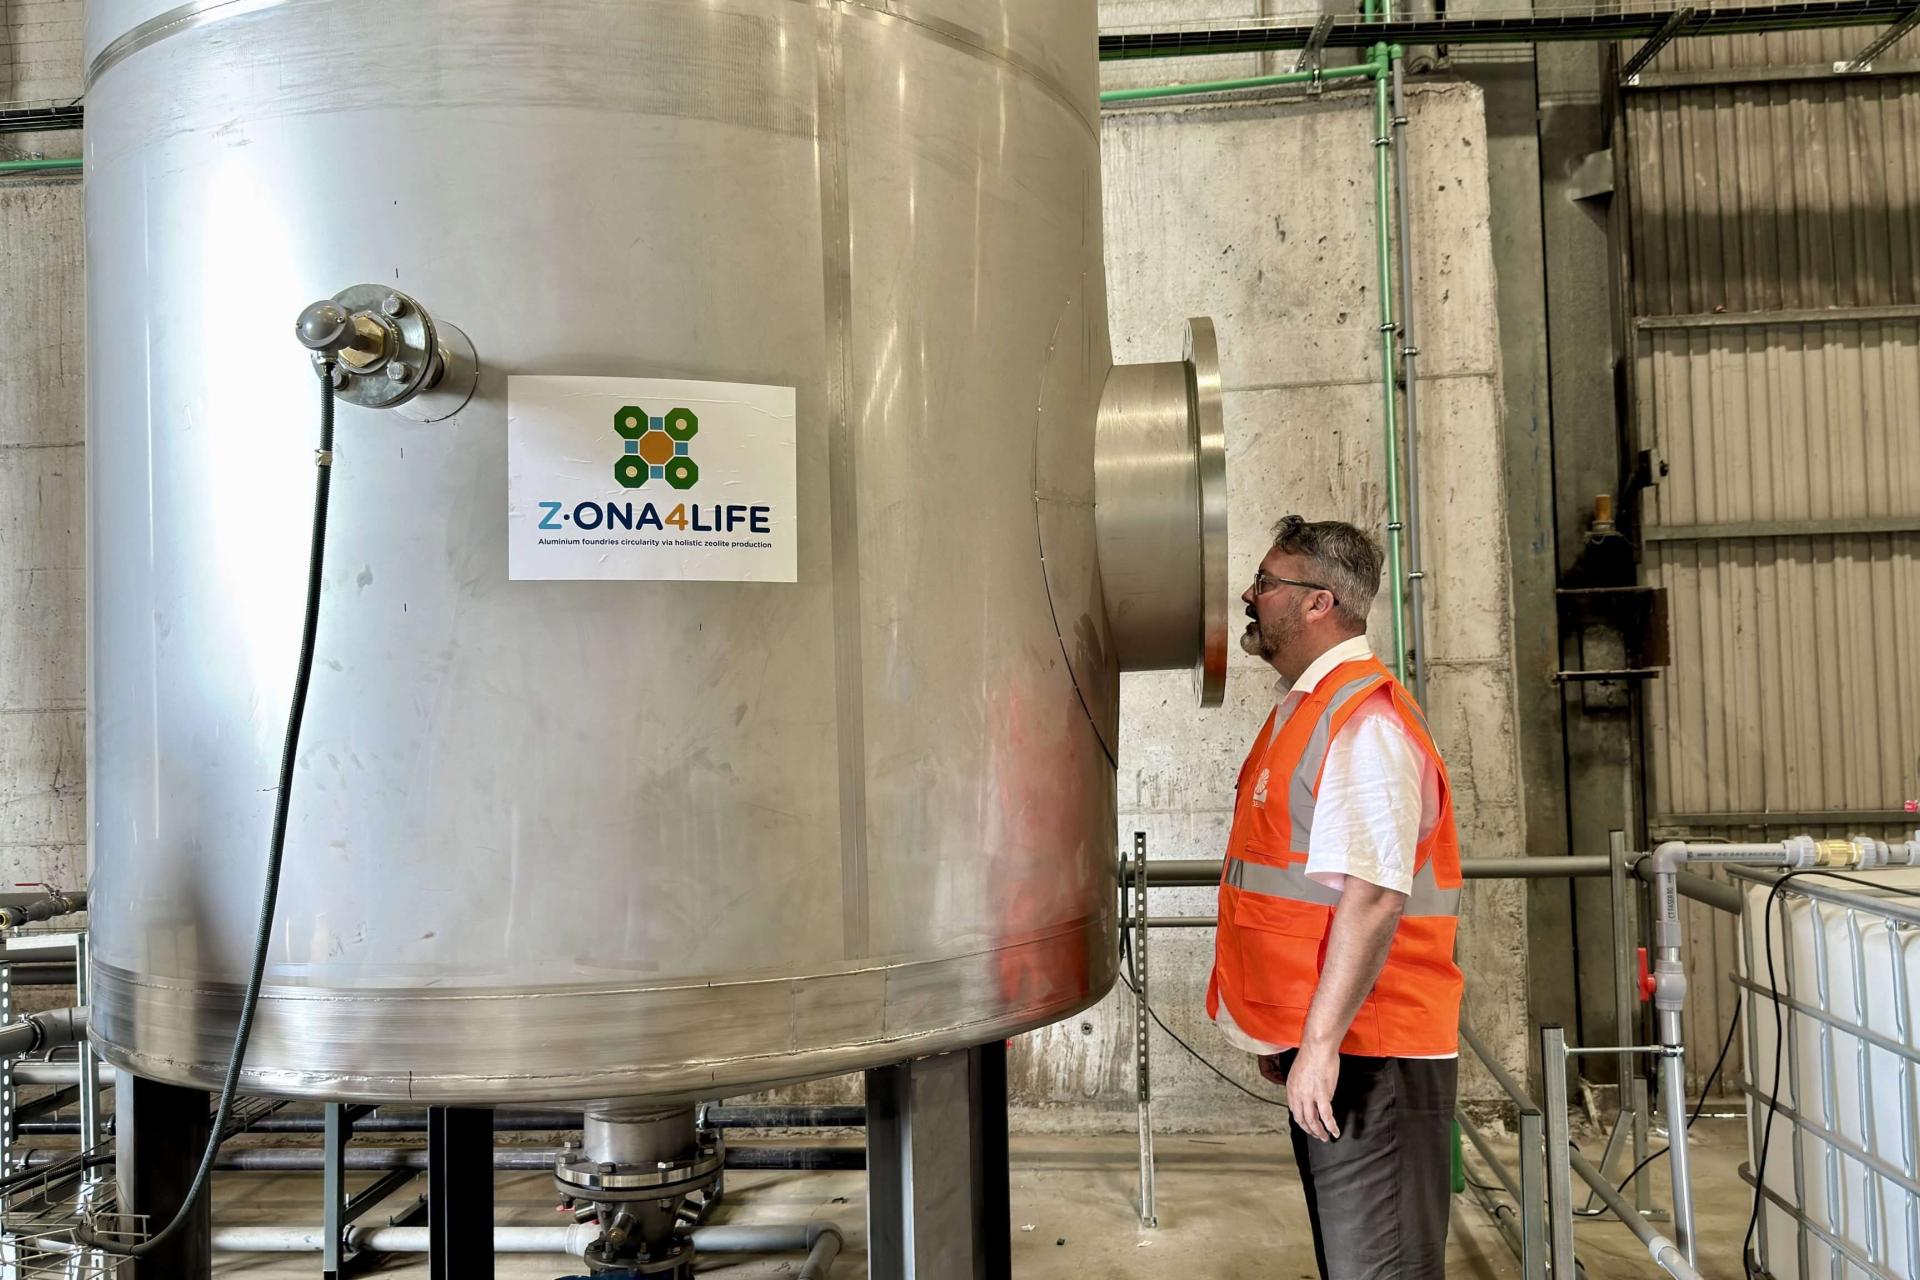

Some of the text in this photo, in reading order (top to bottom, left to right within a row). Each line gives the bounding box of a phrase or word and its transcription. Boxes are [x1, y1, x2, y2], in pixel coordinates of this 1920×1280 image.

[538, 538, 580, 546] Aluminium
[582, 538, 619, 546] foundries
[620, 539, 660, 547] circularity
[731, 541, 772, 549] production
